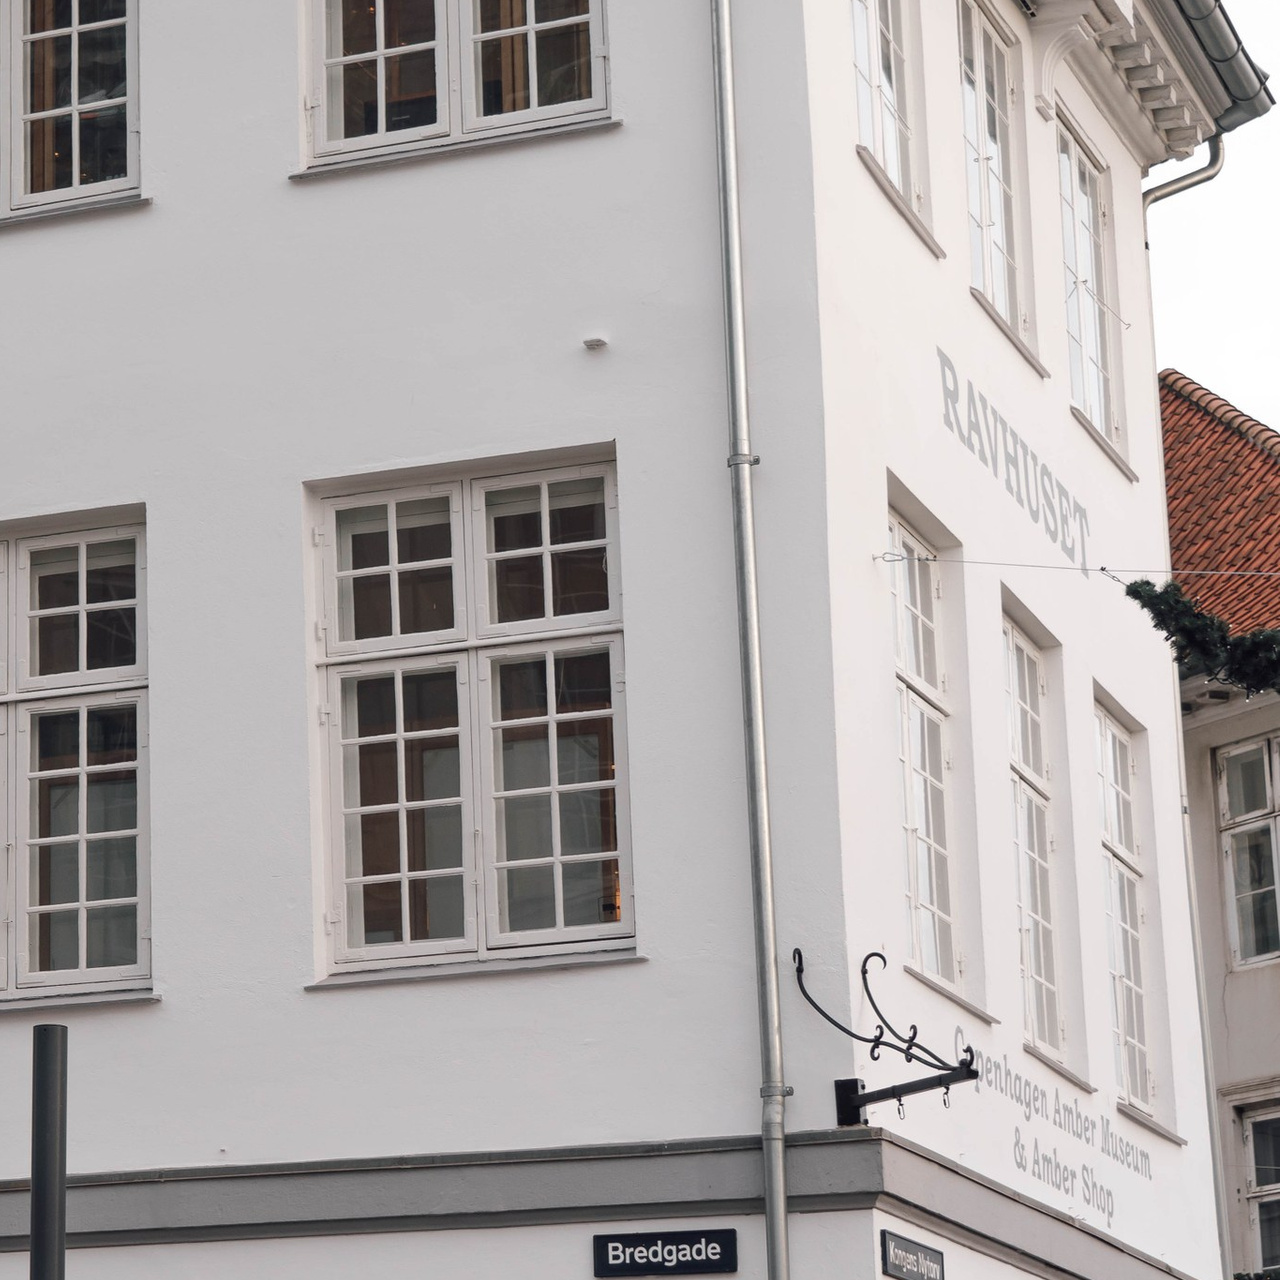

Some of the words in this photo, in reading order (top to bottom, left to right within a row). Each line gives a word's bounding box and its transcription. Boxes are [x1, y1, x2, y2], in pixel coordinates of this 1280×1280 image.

[936, 344, 1090, 580] RAVHUSET
[1013, 1125, 1027, 1172] &
[1031, 1137, 1077, 1198] Amber
[1081, 1163, 1114, 1229] Shop
[1052, 1087, 1097, 1147] Amber
[1100, 1114, 1153, 1181] Museum
[607, 1238, 721, 1267] Bredgade
[889, 1240, 917, 1273] Kongens
[917, 1252, 940, 1280] Nytorv
